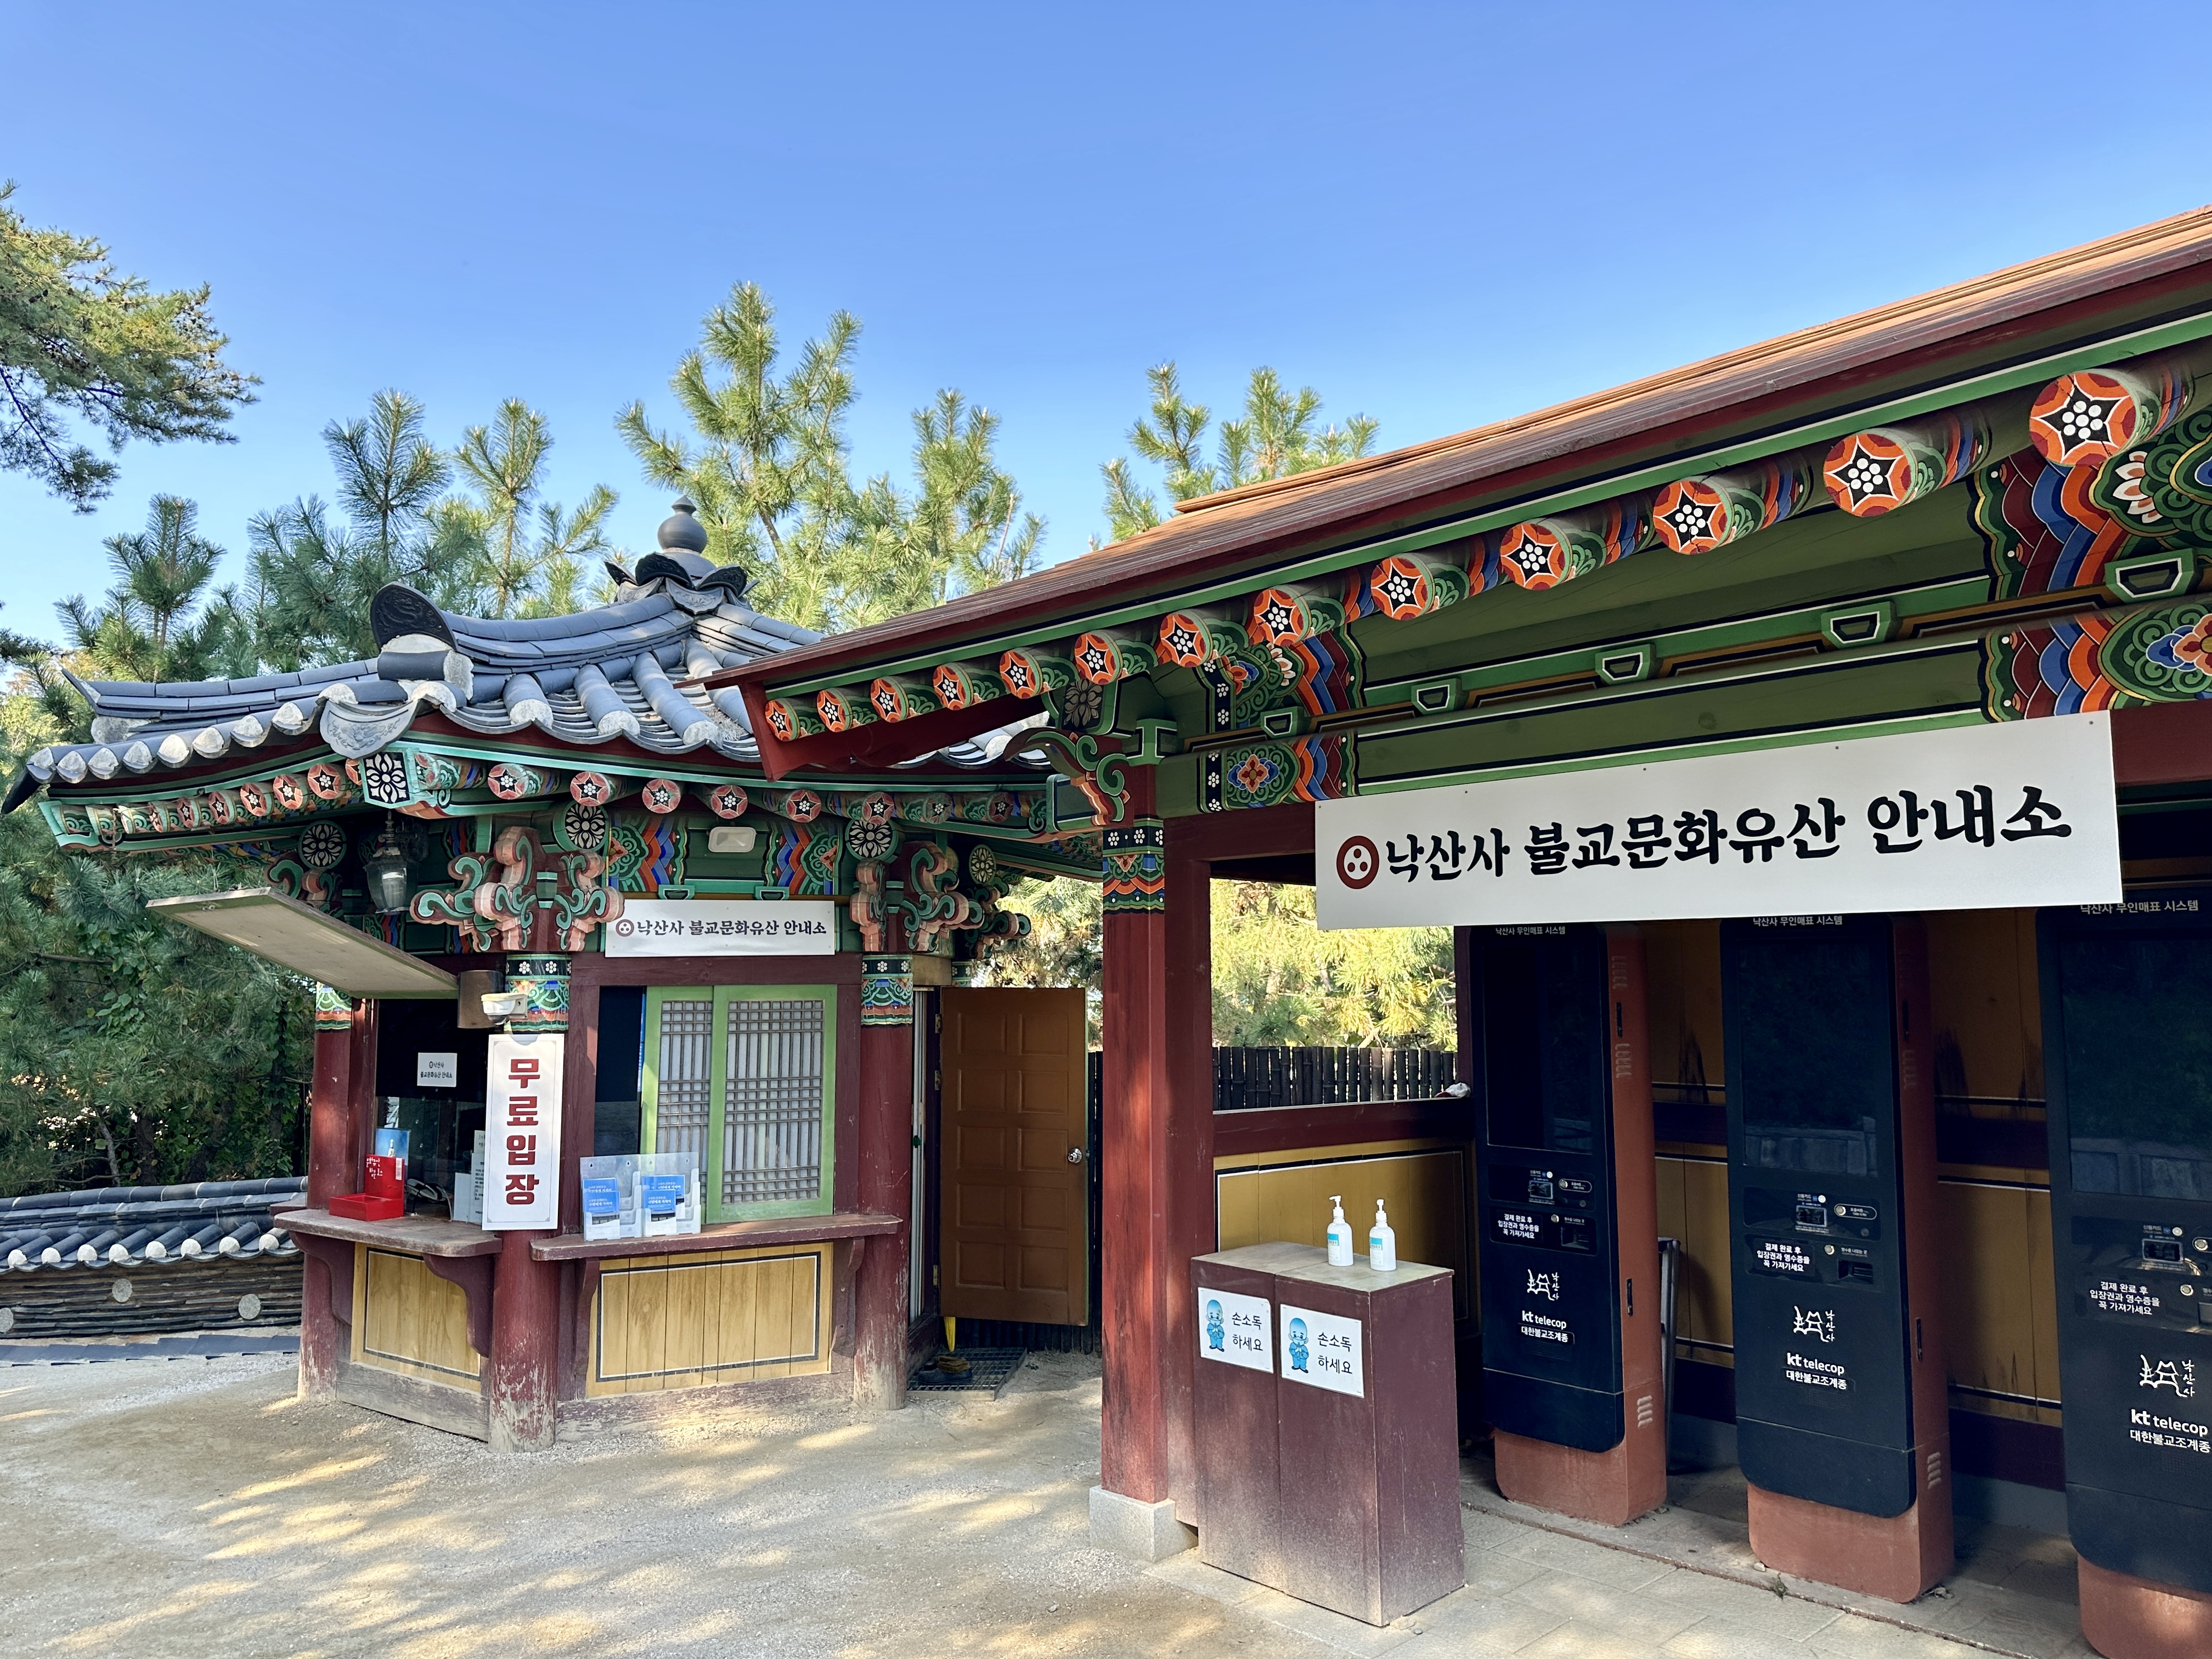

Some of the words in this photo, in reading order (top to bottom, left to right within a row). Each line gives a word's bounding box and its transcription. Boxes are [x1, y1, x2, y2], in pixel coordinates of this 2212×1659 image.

[1385, 828, 1510, 883] 낙산사
[1524, 797, 1846, 876] 불교문화유산
[1867, 785, 2072, 854] 안내소
[2080, 904, 2113, 915] 낙산사
[2116, 901, 2161, 913] 무인매표
[2164, 900, 2199, 912] 시스템
[637, 920, 684, 935] 낙산사
[689, 920, 779, 935] 불교문화유산
[785, 921, 827, 935] 안내소
[1753, 917, 1778, 927] 낙산사
[1780, 916, 1814, 926] 무인매표
[1816, 916, 1843, 925] 시스템
[1496, 927, 1515, 935] 낙산사
[1517, 927, 1543, 935] 무인매표
[1545, 926, 1566, 934] 시스템
[505, 1059, 540, 1205] 무료입장
[1497, 1220, 1518, 1229] 입장권과
[1519, 1223, 1539, 1232] 영수증을
[1515, 1215, 1526, 1223] 완료
[1510, 1229, 1534, 1239] 가져가세요
[1765, 1243, 1778, 1251] 결제
[1780, 1245, 1793, 1254] 완료
[1757, 1250, 1782, 1261] 입장권과
[1784, 1254, 1810, 1265] 영수증을
[1763, 1259, 1770, 1268] 꼭
[1772, 1261, 1804, 1272] 가져가세요
[1551, 1272, 1560, 1300] 낙산사
[2101, 1281, 2117, 1291] 결제
[2119, 1283, 2137, 1294] 완료
[2139, 1285, 2148, 1295] 후
[2090, 1290, 2123, 1302] 입장권과
[2126, 1294, 2160, 1307] 영수증을
[2098, 1301, 2107, 1310] 꼭
[2109, 1302, 2153, 1315] 가져가세요
[1232, 1312, 1262, 1330] 손소독
[1522, 1310, 1534, 1323] kt
[1534, 1315, 1567, 1330] telecop
[1825, 1310, 1836, 1341] 낙산사
[1232, 1334, 1263, 1351] 하세요
[1317, 1332, 1352, 1352] 손소독
[1521, 1326, 1568, 1342] 대한불교조계종
[1318, 1355, 1352, 1374] 하세요
[1787, 1352, 1802, 1367] kt
[1803, 1358, 1844, 1375] telecop
[1786, 1370, 1847, 1390] 대한불교조계종
[2181, 1359, 2196, 1397] 낙산사
[2131, 1408, 2151, 1426] kt
[2153, 1415, 2208, 1437] telecop
[2130, 1429, 2211, 1453] 대한불교조계종
